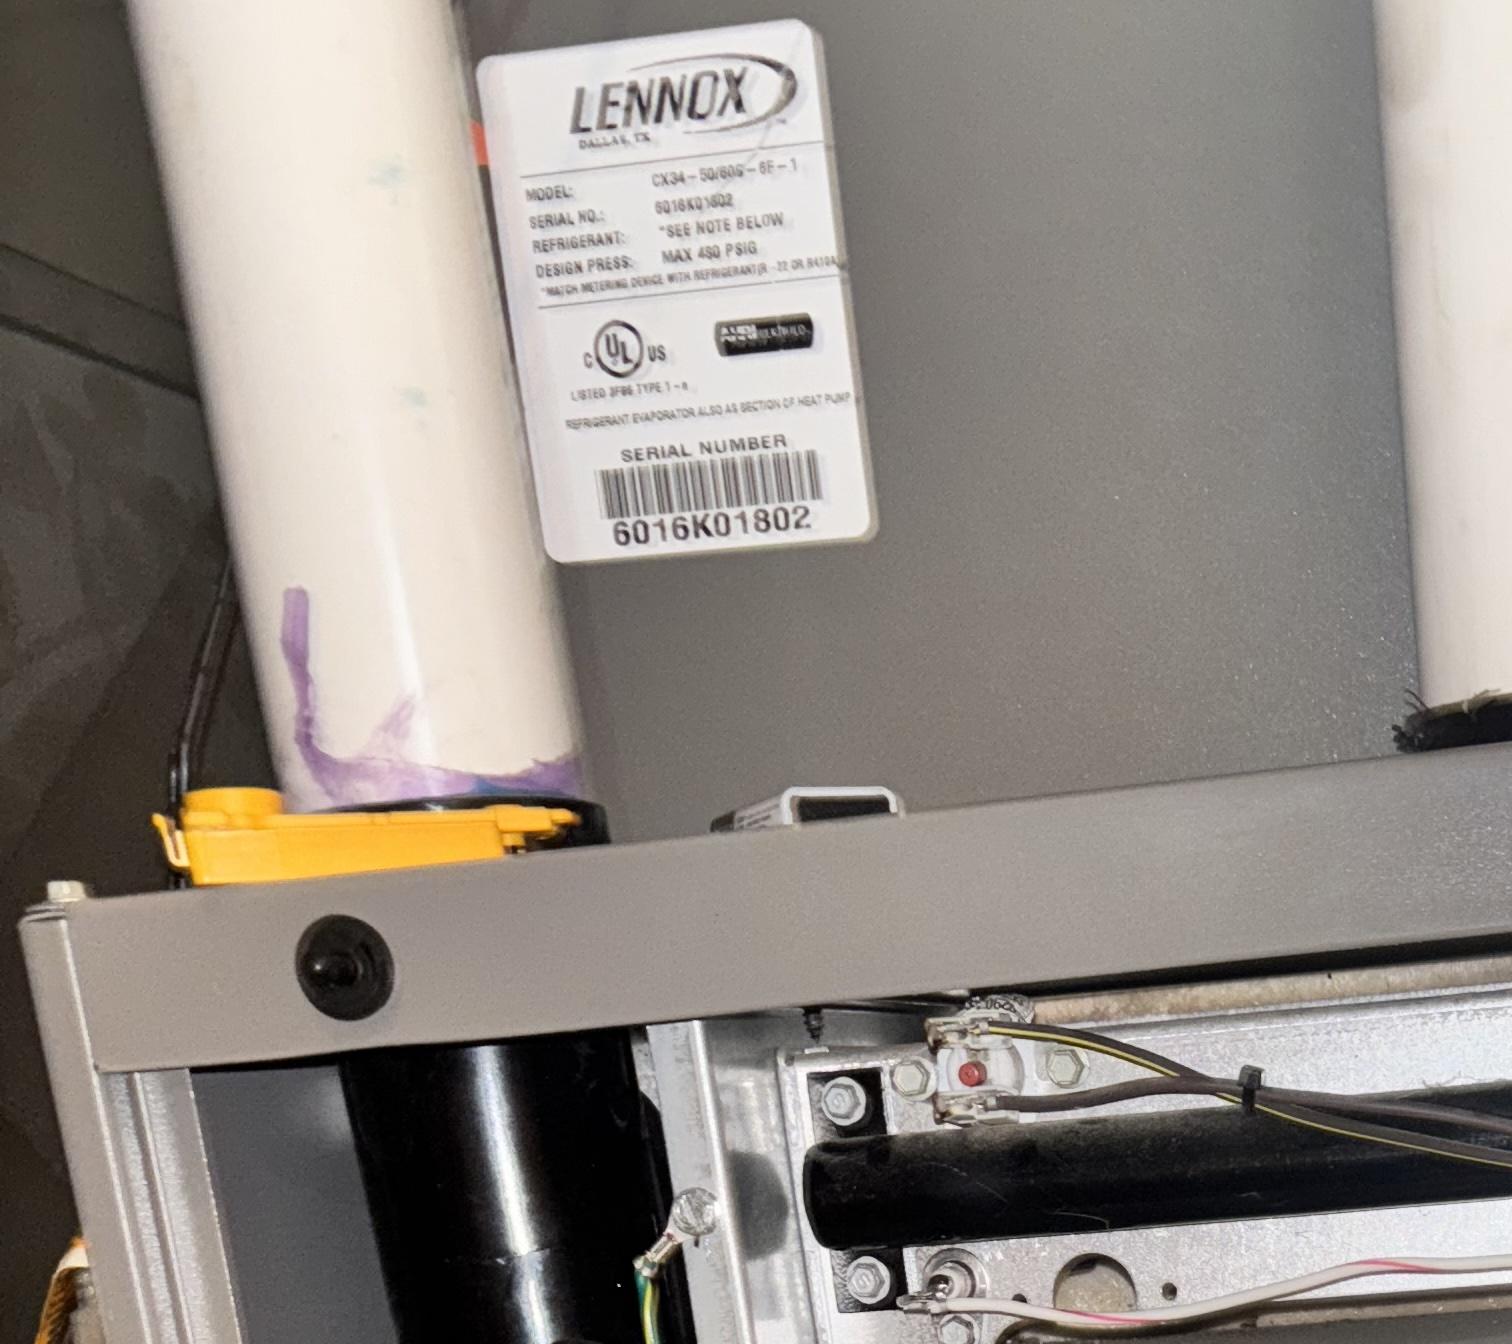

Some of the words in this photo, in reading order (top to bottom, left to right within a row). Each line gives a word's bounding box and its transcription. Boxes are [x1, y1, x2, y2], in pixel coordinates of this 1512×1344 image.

[570, 67, 749, 134] LENNOX
[526, 186, 573, 201] MODEL:
[529, 213, 573, 229] SERIAL
[532, 231, 625, 253] REFRIGERANT:
[696, 220, 731, 235] NOTE
[737, 213, 784, 230] BELOW
[536, 261, 582, 278] DESIGN
[661, 249, 692, 264] MAX
[725, 241, 757, 257] PSIG
[566, 413, 629, 430] REFRIGERANT
[632, 408, 695, 424] EVAPORATOR
[621, 443, 692, 463] SERIAL
[700, 434, 787, 455] NUMBER
[613, 506, 812, 546] 6016K01802
